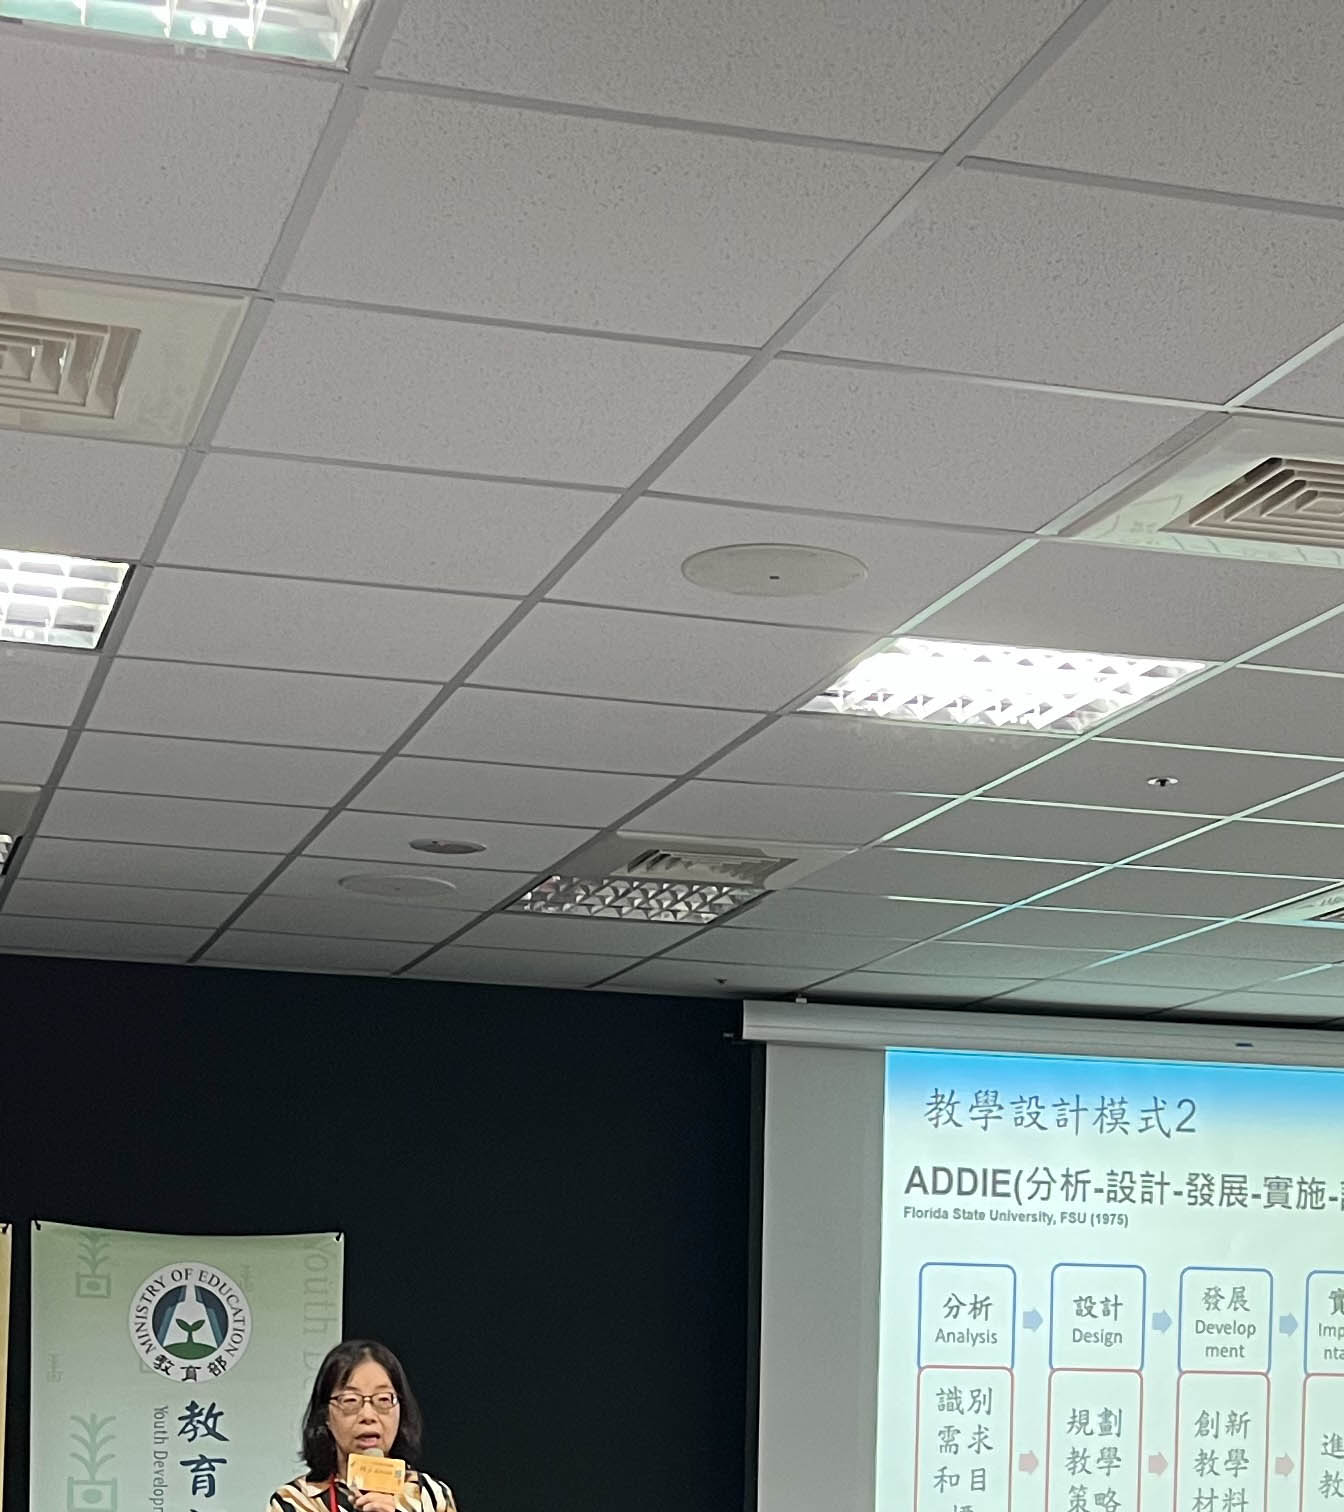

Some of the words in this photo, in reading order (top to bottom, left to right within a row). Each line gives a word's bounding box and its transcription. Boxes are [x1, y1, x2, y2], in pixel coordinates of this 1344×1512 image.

[923, 1087, 1197, 1139] 教學設計模式2
[903, 1206, 949, 1220] Florida
[953, 1207, 986, 1221] State
[989, 1208, 1057, 1226] University,
[1060, 1211, 1087, 1225] FSU
[1090, 1212, 1129, 1229] (1975)
[134, 1274, 167, 1355] MINISTRY
[170, 1268, 194, 1282] OF
[198, 1269, 246, 1357] EDUCATION
[942, 1293, 993, 1321] 分析
[1072, 1294, 1124, 1321] 設計
[1201, 1285, 1251, 1313] 發展
[935, 1328, 998, 1347] Analysis
[1072, 1328, 1123, 1347] Design
[1195, 1319, 1257, 1339] Develop
[1205, 1345, 1246, 1359] ment
[153, 1353, 228, 1382] 教育部
[935, 1386, 994, 1416] 識別
[153, 1405, 169, 1445] Youth
[1066, 1407, 1124, 1438] 規劃
[1193, 1409, 1252, 1440] 創新
[937, 1424, 994, 1455] 需求
[1064, 1446, 1122, 1477] 教學
[1192, 1448, 1251, 1479] 教學
[933, 1465, 987, 1494] 和目
